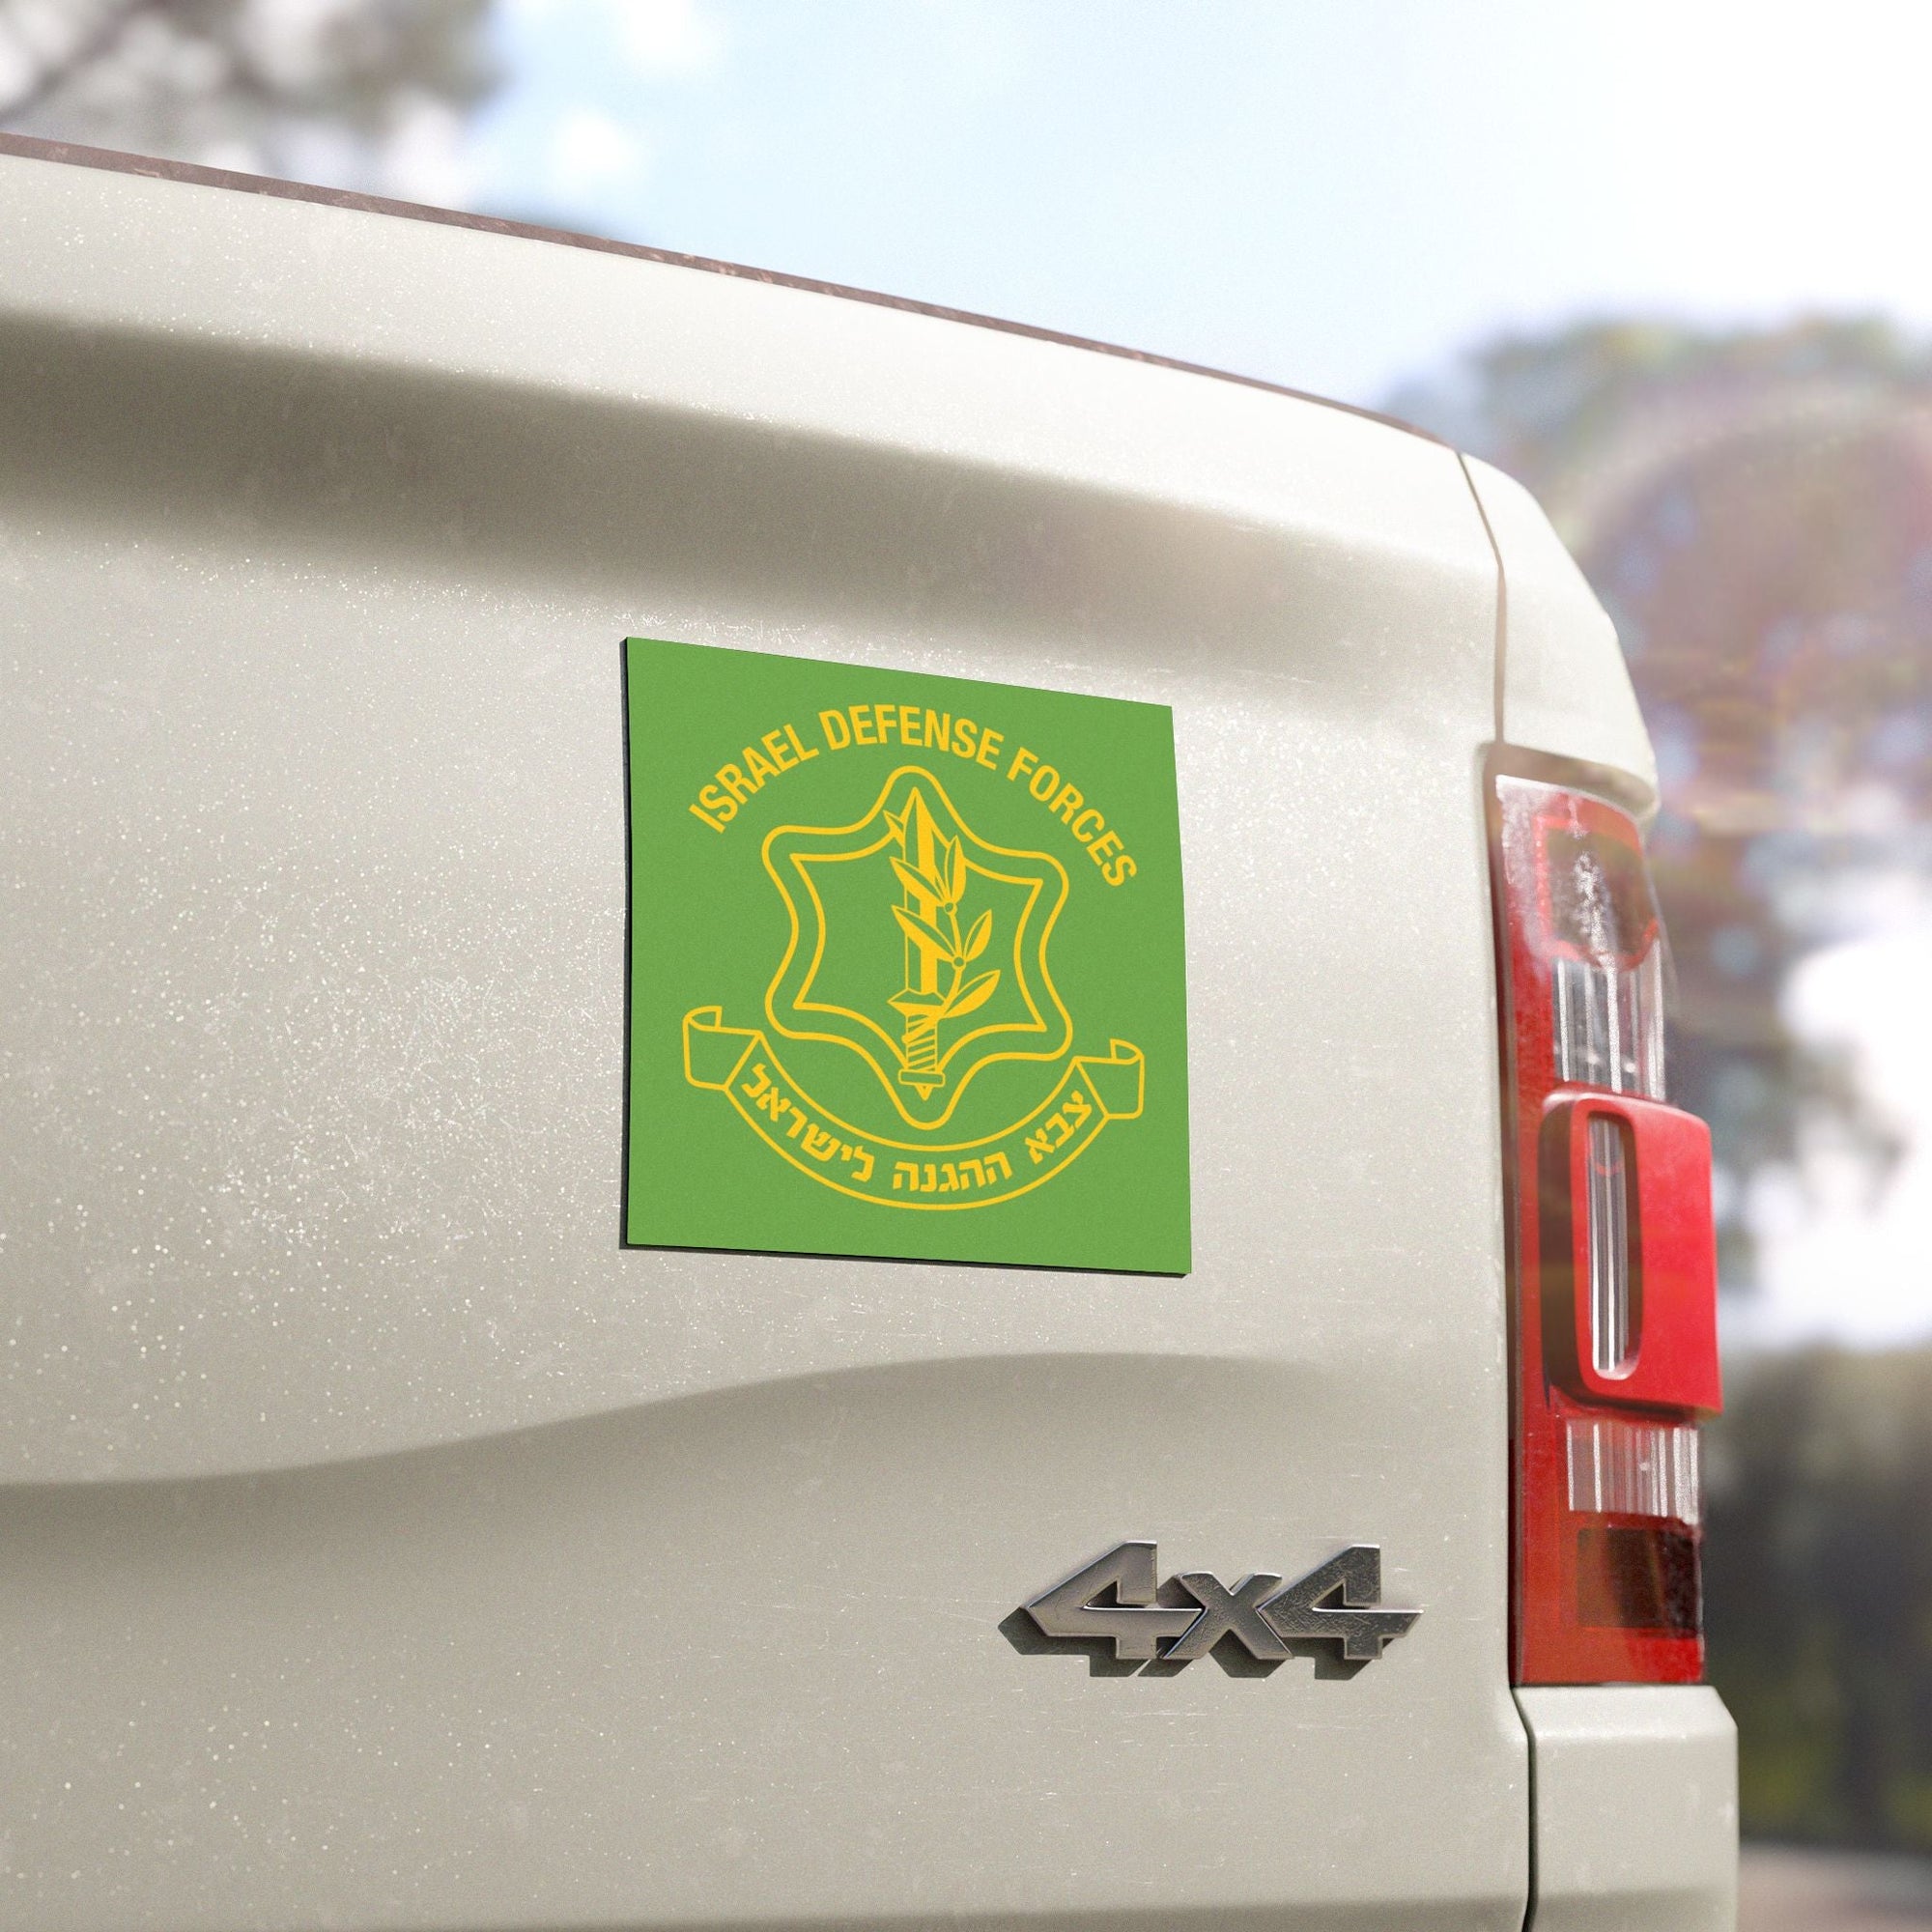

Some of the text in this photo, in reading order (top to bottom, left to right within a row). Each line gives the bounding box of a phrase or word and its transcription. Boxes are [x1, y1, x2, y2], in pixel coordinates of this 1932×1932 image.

[688, 703, 1138, 887] ISRAEL DEFENSE FORCES
[741, 1063, 1093, 1193] צבא ההגנה לישראל
